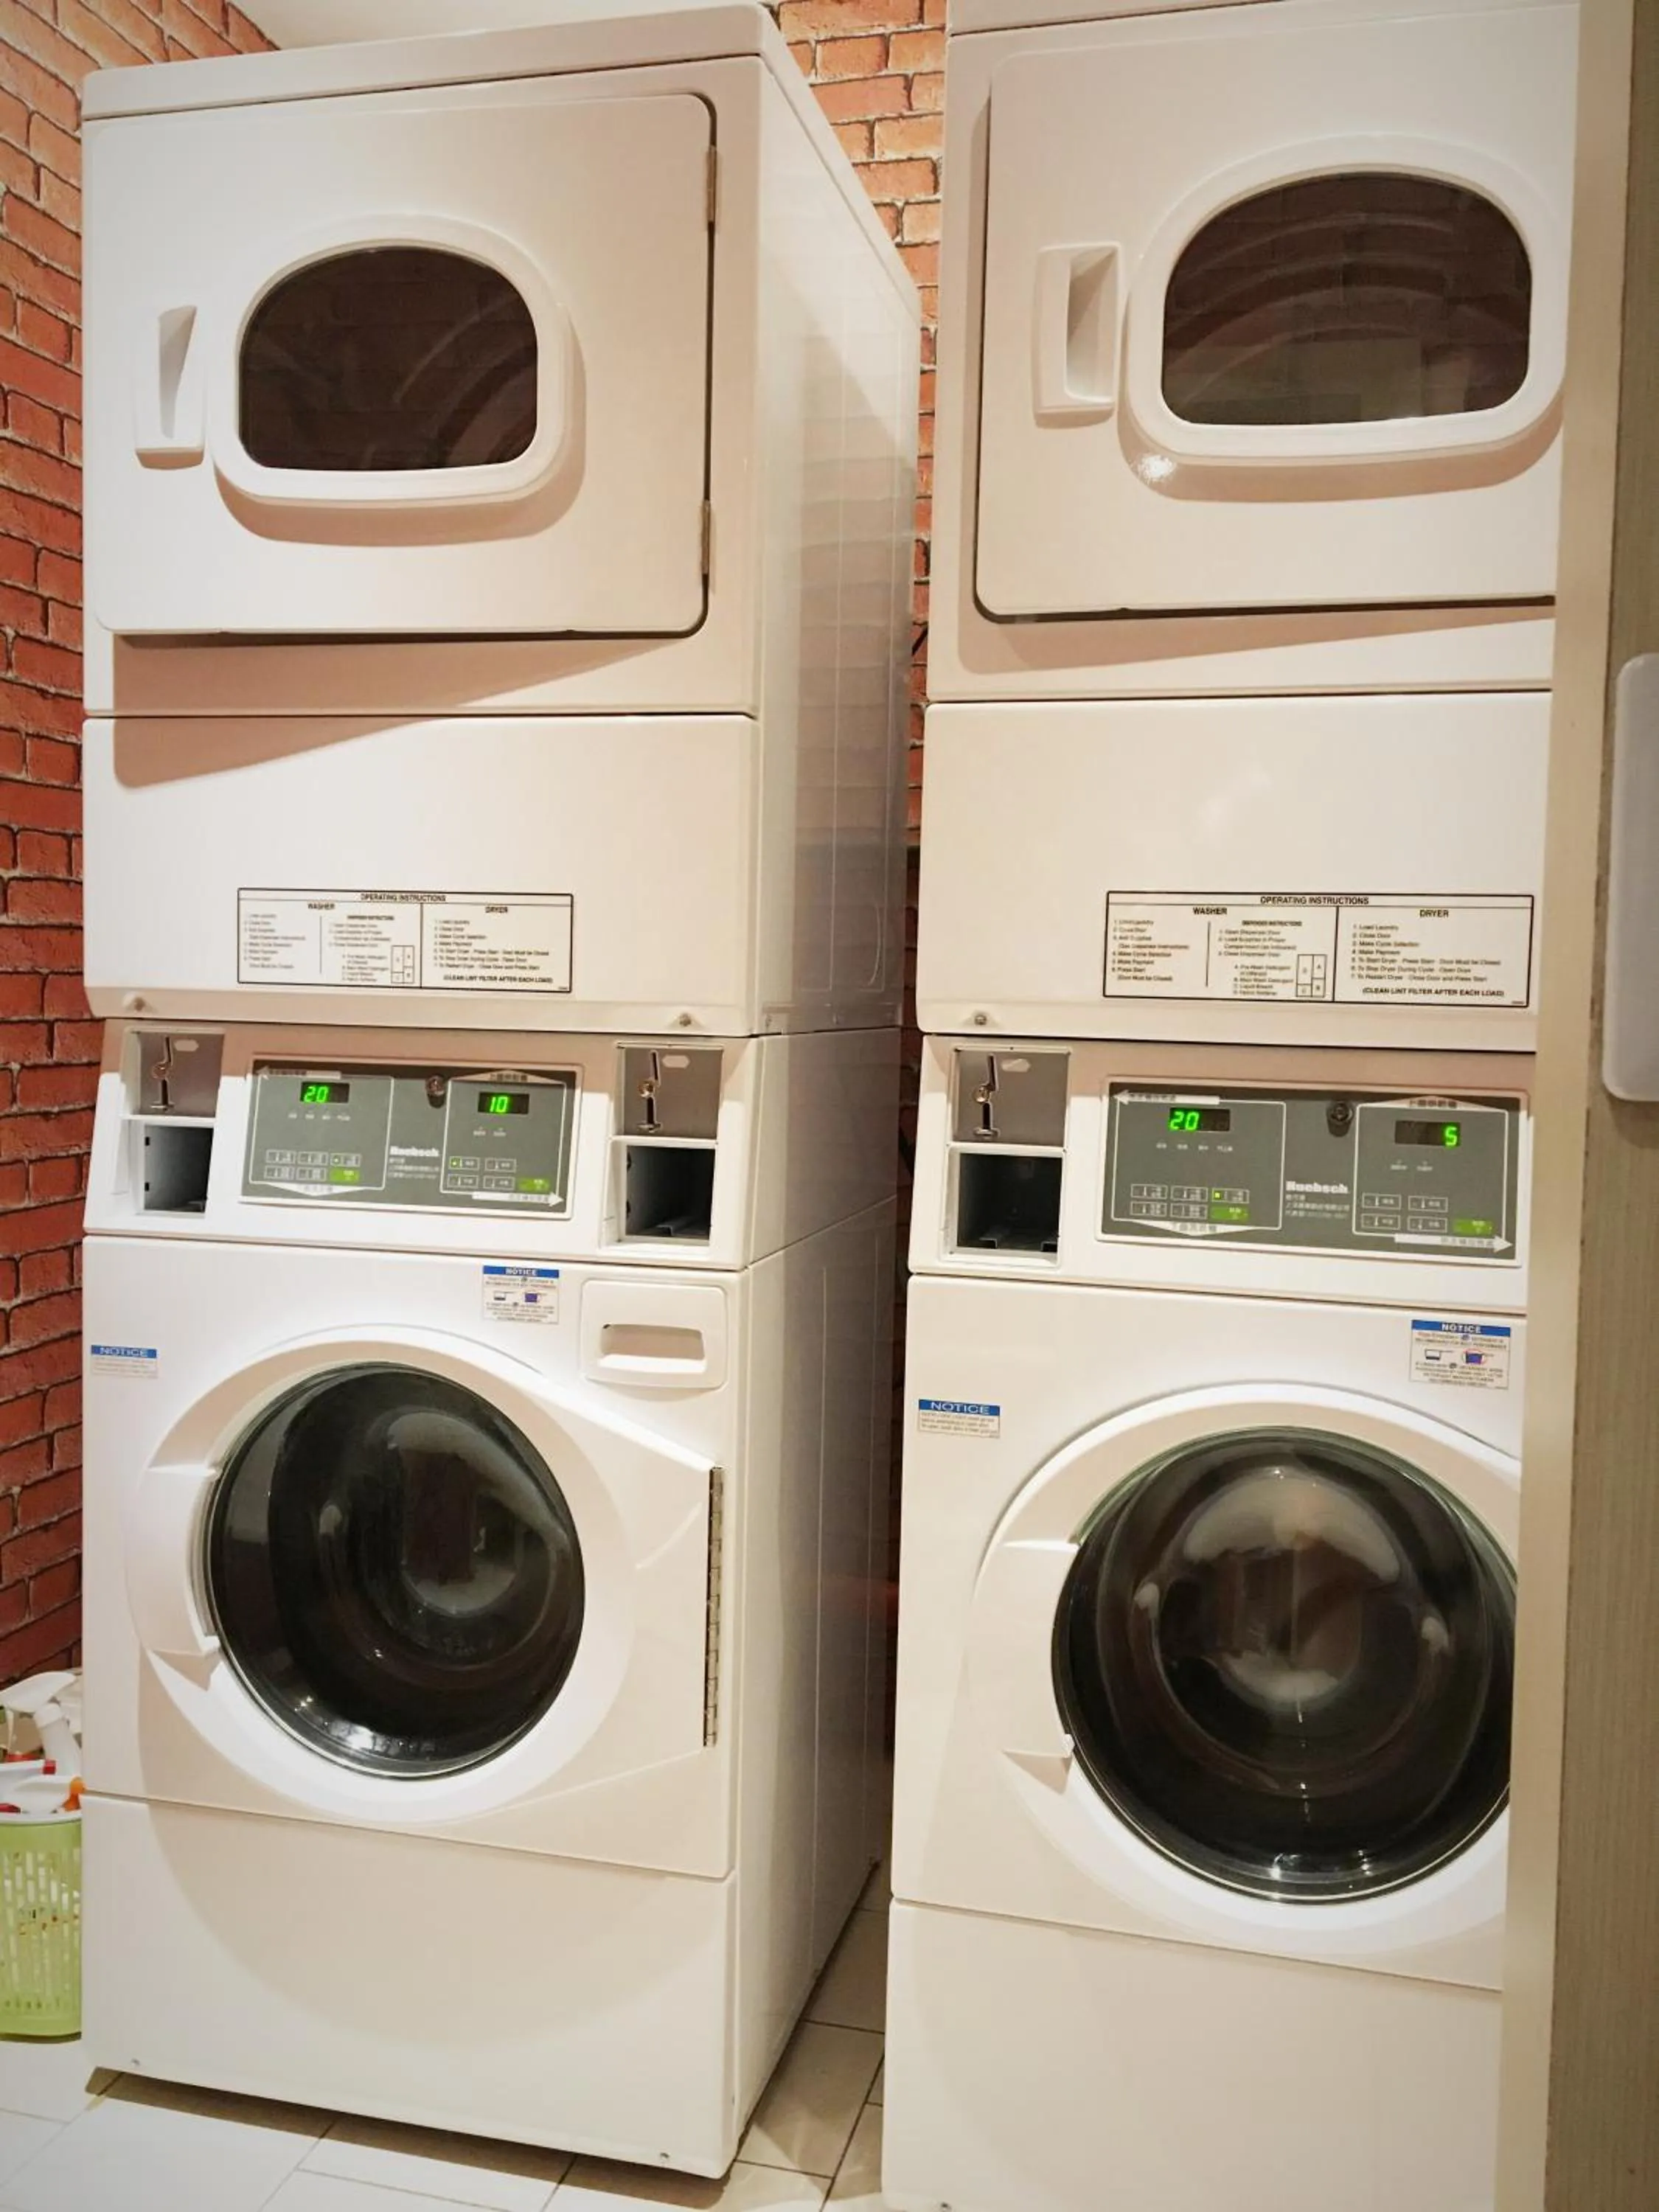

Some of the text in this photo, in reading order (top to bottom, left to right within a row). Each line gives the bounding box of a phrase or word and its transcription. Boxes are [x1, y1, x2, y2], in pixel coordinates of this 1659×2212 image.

[361, 893, 446, 902] OPERATING INSTRUCTIONS
[1259, 896, 1369, 905] OPERATING INSTRUCTIONS
[1192, 907, 1228, 915] WASHER
[1419, 909, 1449, 918] DRYER
[303, 1085, 330, 1104] 20
[489, 1095, 509, 1113] 10
[1169, 1110, 1200, 1131] 20
[1444, 1125, 1458, 1146] 5
[506, 1267, 538, 1276] NOTICE
[1441, 1324, 1481, 1334] NOTICE
[100, 1347, 147, 1357] NOTICE
[931, 1401, 990, 1415] NOTICE
